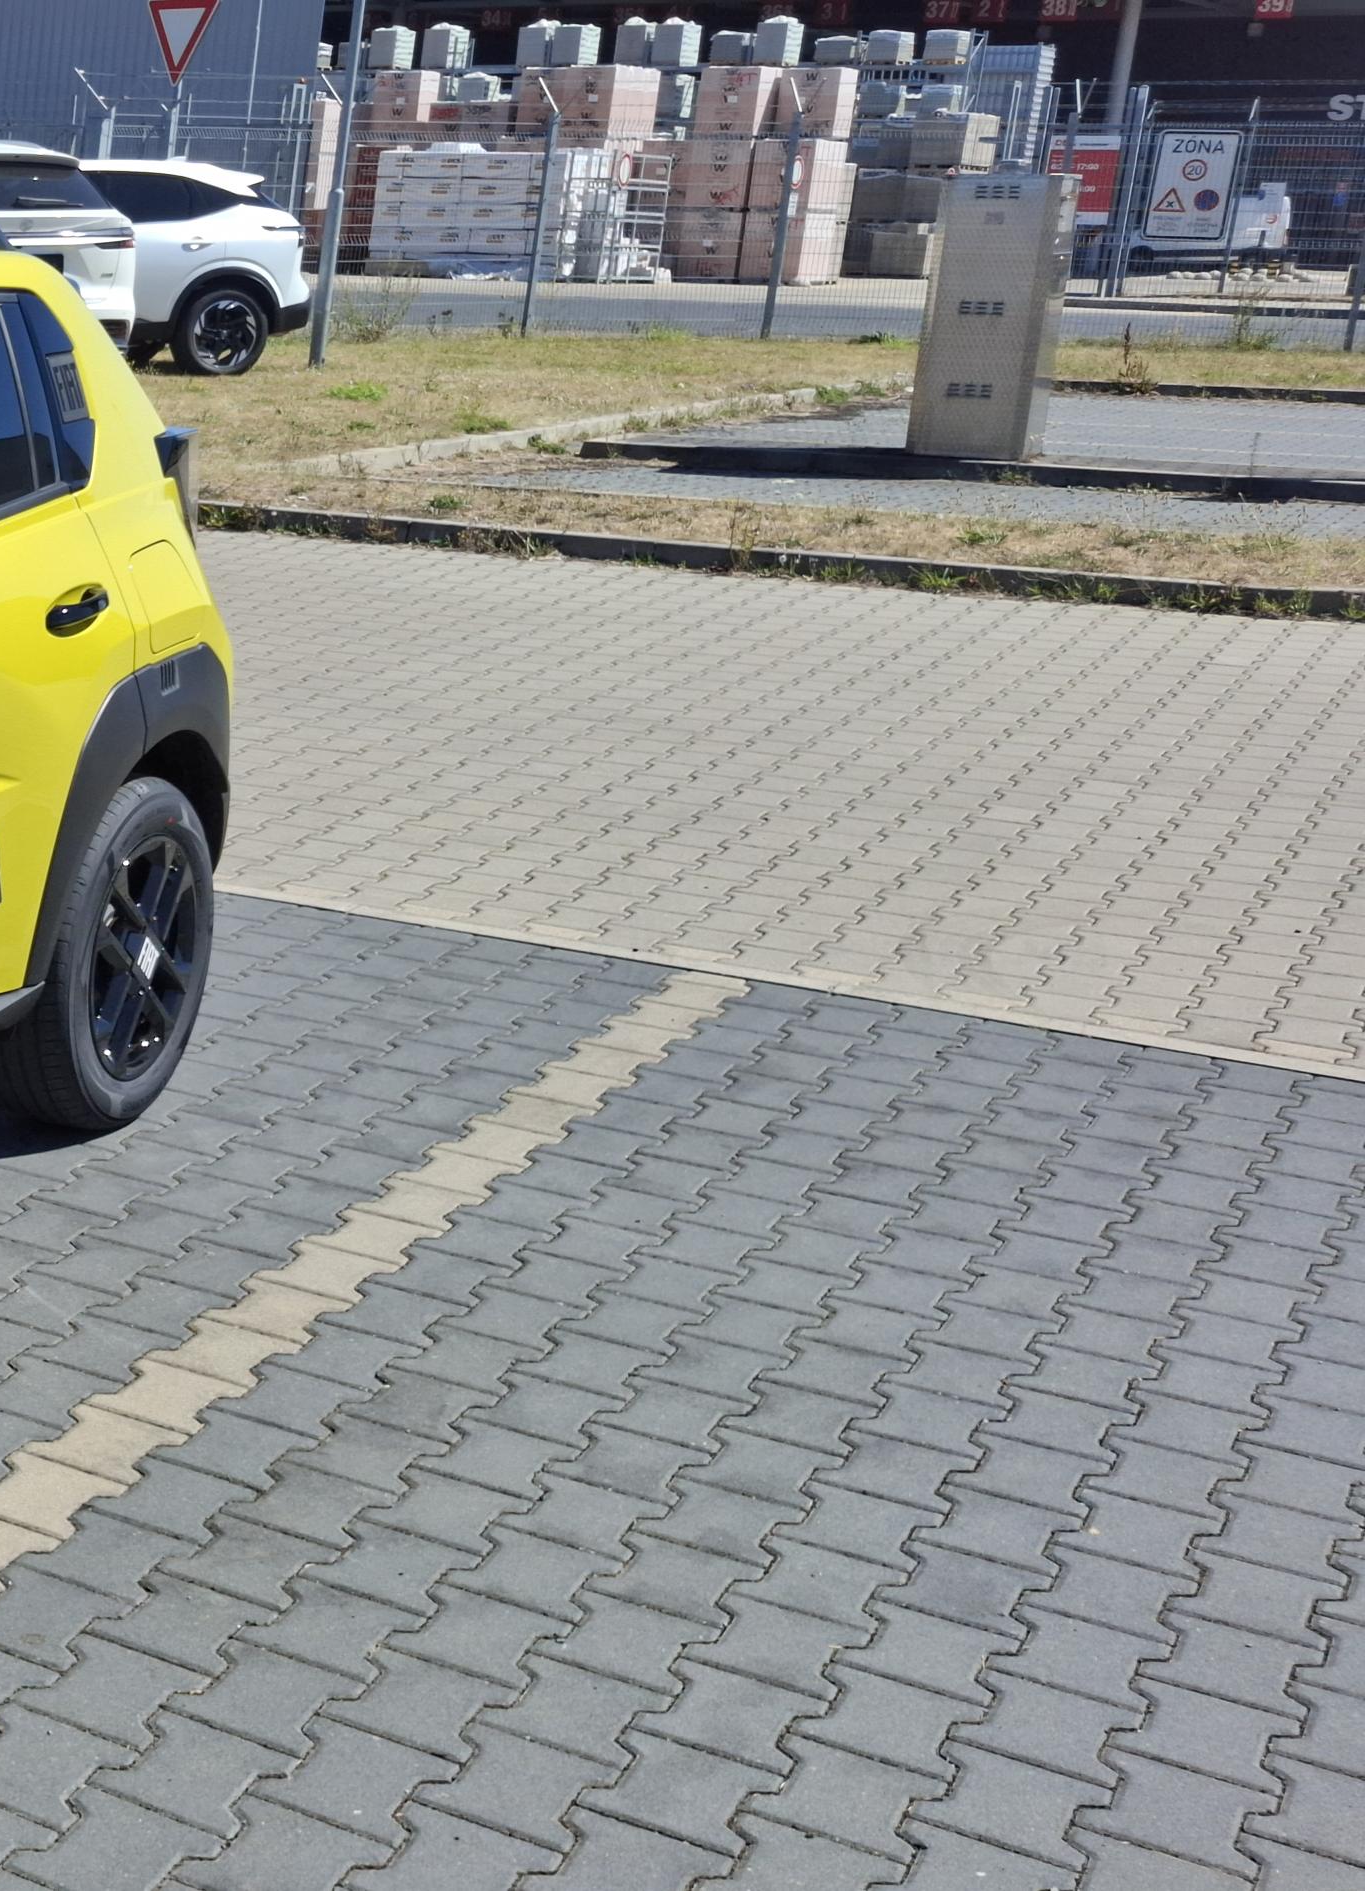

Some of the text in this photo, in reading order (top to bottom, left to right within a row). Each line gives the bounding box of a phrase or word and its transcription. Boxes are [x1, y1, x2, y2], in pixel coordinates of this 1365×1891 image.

[925, 1, 950, 18] 37
[1042, 0, 1066, 16] 38
[1172, 135, 1225, 154] ZÓNA
[1186, 164, 1202, 176] 20
[53, 362, 85, 412] FIAT
[137, 936, 161, 981] FIAT
